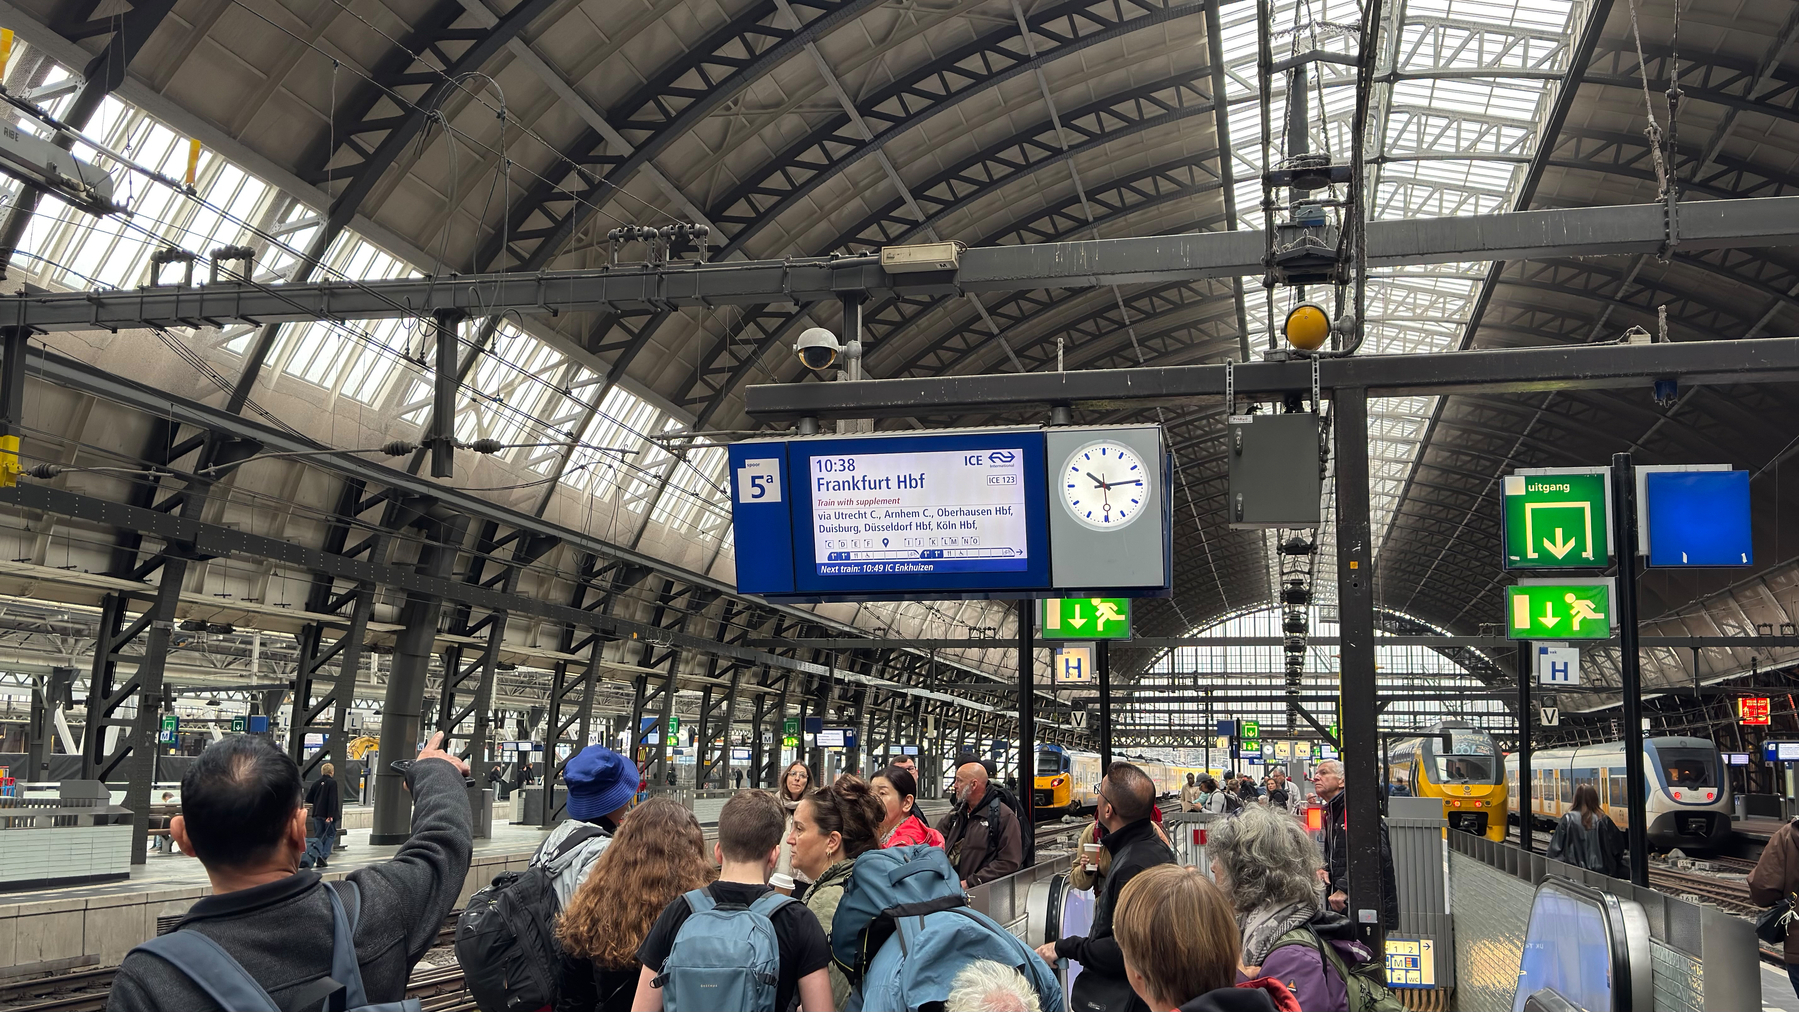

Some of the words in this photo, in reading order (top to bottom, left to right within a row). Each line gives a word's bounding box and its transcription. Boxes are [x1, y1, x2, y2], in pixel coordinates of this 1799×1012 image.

[816, 458, 856, 472] 10:38
[964, 455, 983, 466] ICE
[817, 474, 892, 492] Frankfurt
[896, 473, 926, 490] Hbf
[1528, 482, 1570, 494] uitgang
[837, 498, 854, 506] with
[856, 497, 900, 507] supplement
[818, 512, 832, 520] via
[834, 510, 868, 520] Utrecht
[870, 510, 881, 520] C.,
[884, 509, 920, 519] Arnhem
[922, 508, 934, 518] C.,
[937, 507, 992, 517] Oberhausen
[995, 506, 1014, 516] Hbf,
[819, 524, 861, 534] Duisburg,
[864, 522, 912, 532] Düsseldorf
[915, 521, 933, 531] Hbf,
[937, 520, 957, 530] Köln
[960, 520, 978, 530] Hbf,
[840, 565, 860, 573] train:
[895, 563, 934, 572] Enkhuizen
[1065, 658, 1082, 678] H
[1551, 661, 1568, 681] H
[1073, 712, 1084, 726] V
[1543, 709, 1556, 724] V
[1394, 959, 1403, 967] M
